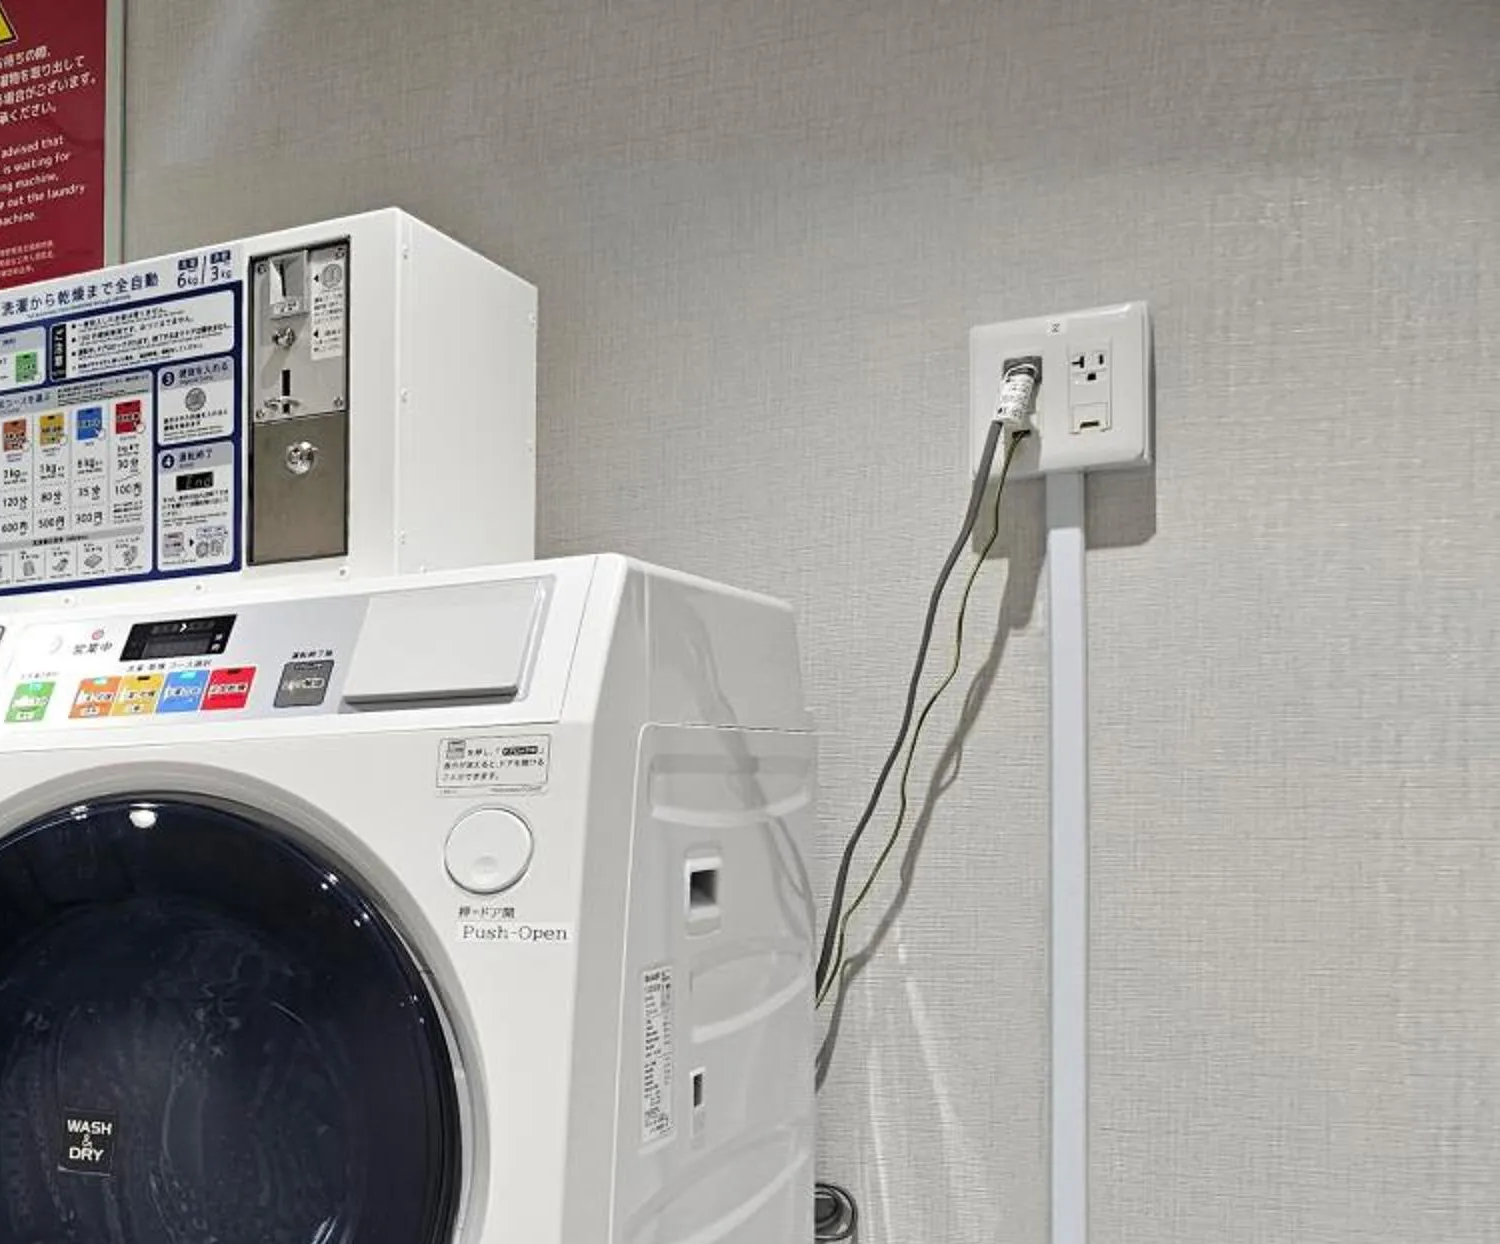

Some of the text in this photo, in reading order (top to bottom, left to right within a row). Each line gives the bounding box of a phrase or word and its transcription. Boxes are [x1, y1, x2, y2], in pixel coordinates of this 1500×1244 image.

[1, 140, 39, 159] advised
[41, 135, 64, 149] that
[3, 165, 12, 175] is
[13, 156, 53, 172] waiting
[55, 151, 71, 164] for
[7, 195, 25, 208] out
[27, 191, 45, 202] the
[47, 182, 86, 200] laundry
[1, 271, 159, 316] 洗濯から乾燥まで全自動
[463, 925, 567, 942] Push-Open
[67, 1119, 113, 1136] WASH
[81, 1134, 92, 1148] &
[69, 1147, 104, 1162] DRY
